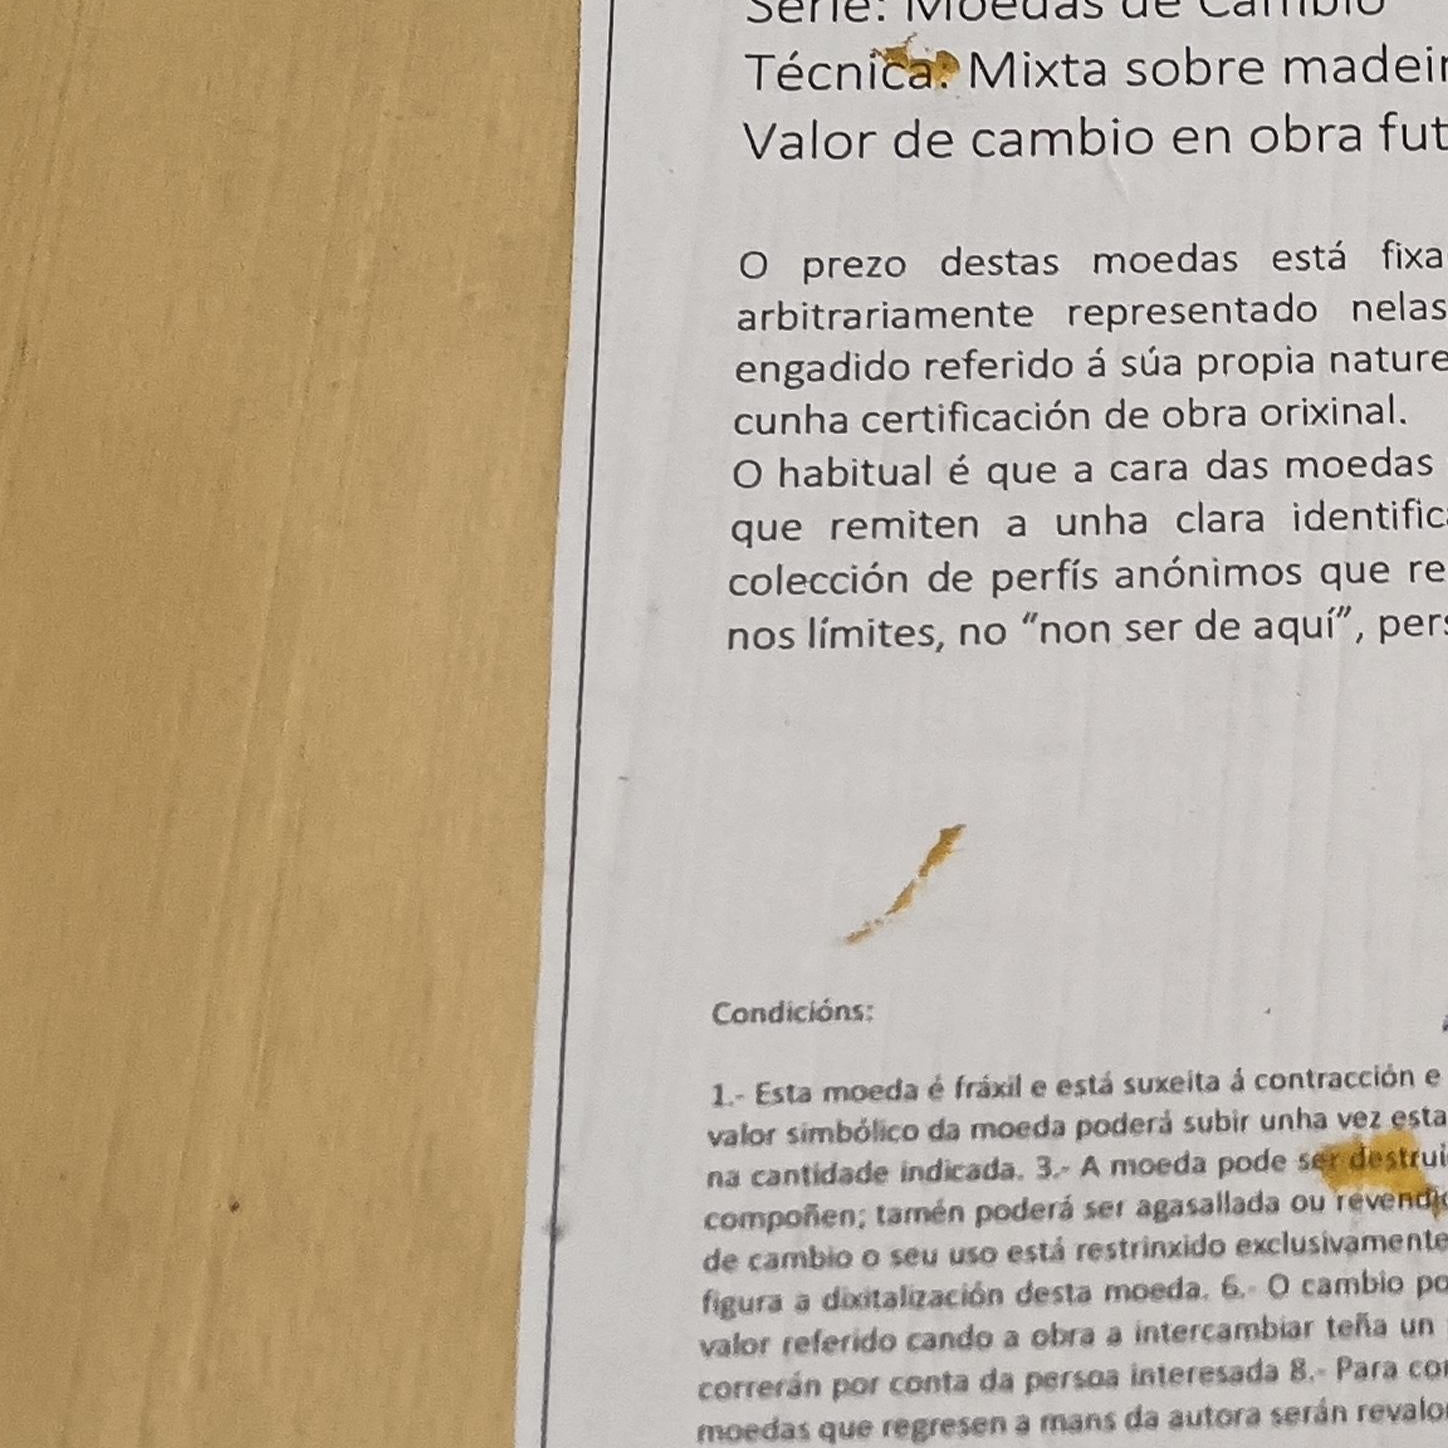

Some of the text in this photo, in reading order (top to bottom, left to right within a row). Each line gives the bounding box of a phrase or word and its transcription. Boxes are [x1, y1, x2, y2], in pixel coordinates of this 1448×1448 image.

[742, 49, 960, 92] Técnica:
[969, 49, 1106, 89] Mixta
[1125, 44, 1265, 87] sobre
[741, 117, 878, 161] Valor
[892, 116, 954, 159] de
[971, 114, 1154, 158] cambio
[1171, 124, 1231, 155] en
[1249, 110, 1362, 154] obra
[738, 250, 768, 279] O
[802, 255, 907, 286] prezo
[939, 244, 1060, 277] destas
[1092, 241, 1238, 275] moedas
[1271, 238, 1346, 272] está
[736, 299, 1034, 332] arbitrariamente
[1067, 290, 1318, 333] representado
[735, 347, 910, 391] engadido
[923, 346, 1073, 381] referido
[1086, 345, 1105, 378] á
[1120, 344, 1181, 378] súa
[1197, 343, 1314, 383] propia
[733, 391, 1407, 436] cunha certificación de obra orixinal.
[732, 458, 762, 489] O
[778, 452, 931, 488] habitual
[948, 452, 970, 485] é
[986, 461, 1057, 491] que
[1073, 460, 1092, 483] a
[1109, 457, 1188, 482] cara
[1205, 447, 1268, 480] das
[1285, 444, 1434, 479] moedas
[730, 518, 802, 549] que
[829, 508, 979, 541] remiten
[1006, 514, 1027, 537] a
[1055, 501, 1147, 537] unha
[1175, 497, 1264, 534] clara
[728, 560, 908, 596] colección
[927, 559, 973, 593] de
[991, 556, 1098, 600] perfís
[1114, 553, 1302, 589] anónimos
[1319, 560, 1390, 592] que
[726, 626, 795, 651] nos
[807, 615, 945, 654] límites,
[959, 622, 1007, 647] no
[1123, 617, 1184, 642] ser
[1194, 606, 1240, 641] de
[710, 997, 874, 1026] Condicións:
[711, 1082, 744, 1108] 1.-
[754, 1080, 812, 1106] Esta
[822, 1076, 919, 1103] moeda
[927, 1072, 944, 1102] é
[953, 1072, 1022, 1101] fráxil
[1030, 1079, 1047, 1098] e
[1054, 1069, 1114, 1099] está
[1122, 1068, 1220, 1096] suxeita
[1228, 1066, 1245, 1094] á
[1253, 1062, 1415, 1091] contracción
[1423, 1067, 1441, 1088] e
